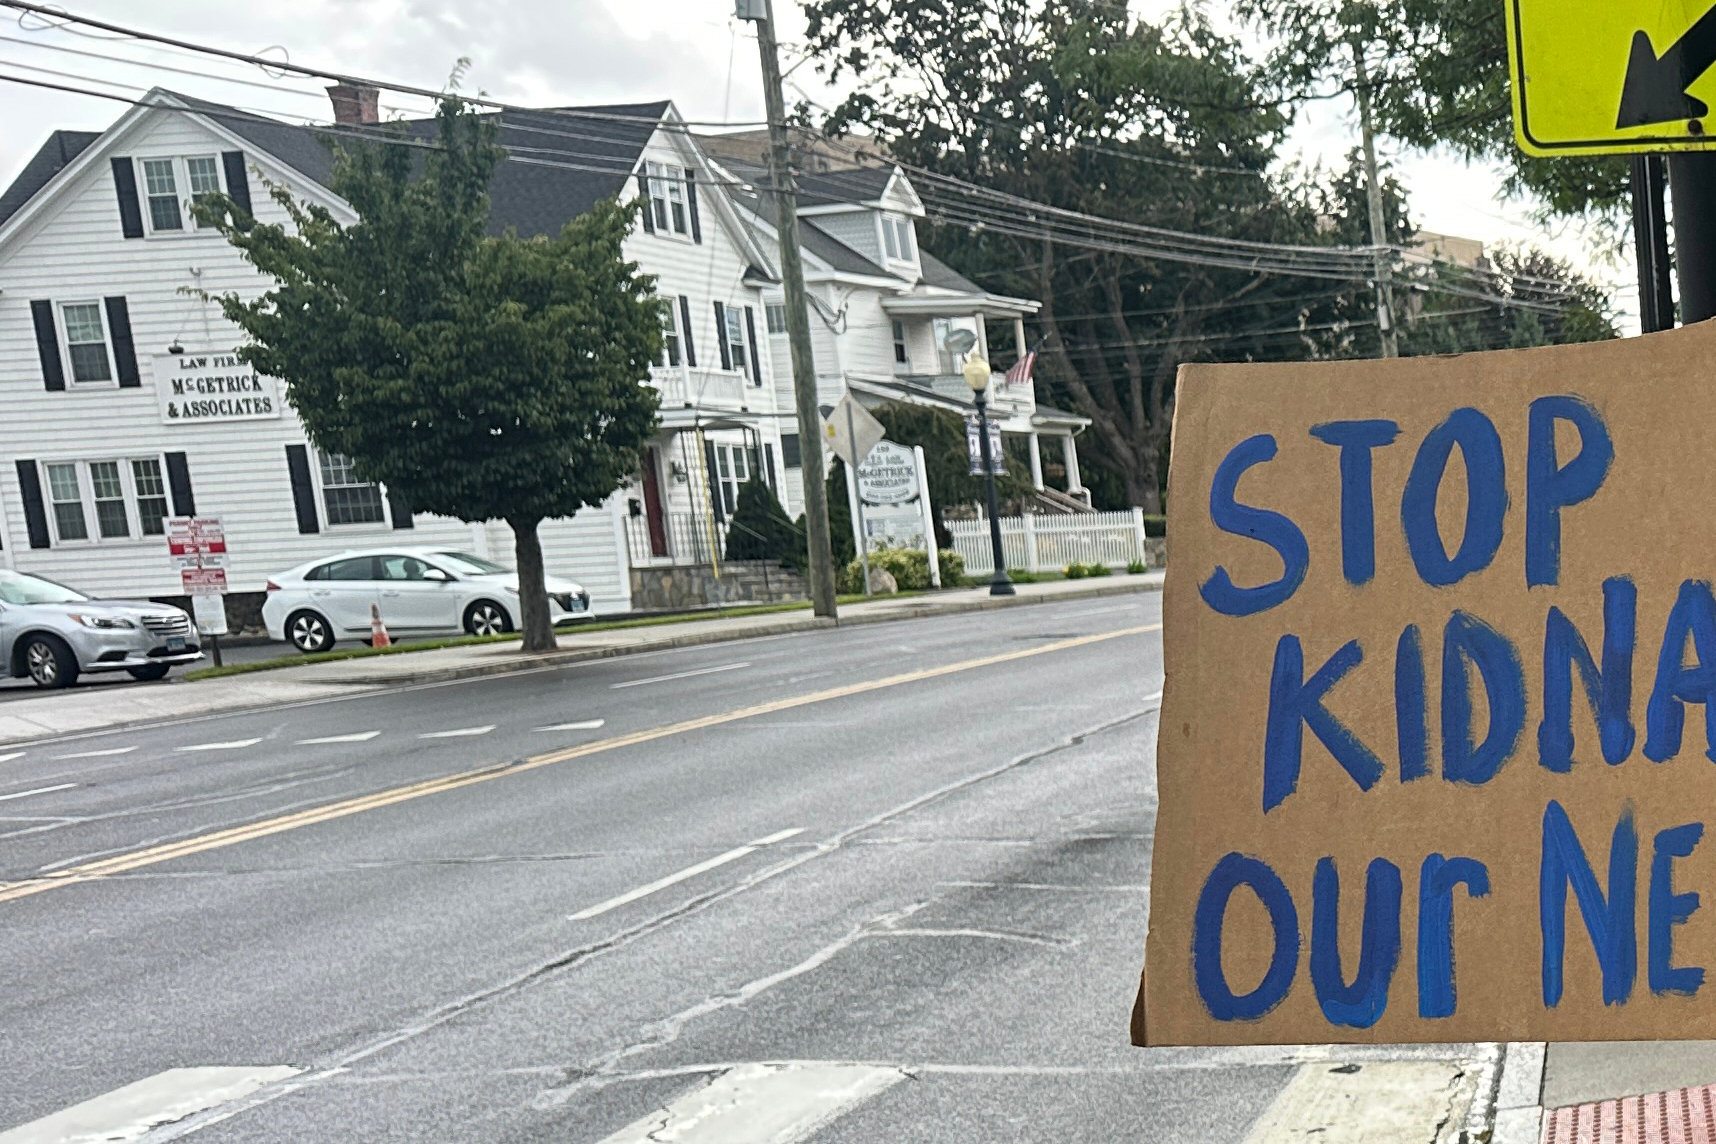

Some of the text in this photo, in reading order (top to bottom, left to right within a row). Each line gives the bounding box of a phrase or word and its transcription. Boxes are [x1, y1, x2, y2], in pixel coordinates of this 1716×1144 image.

[180, 357, 207, 369] LAW
[168, 396, 272, 418] & ASSOCIATES
[1198, 394, 1615, 617] STOP
